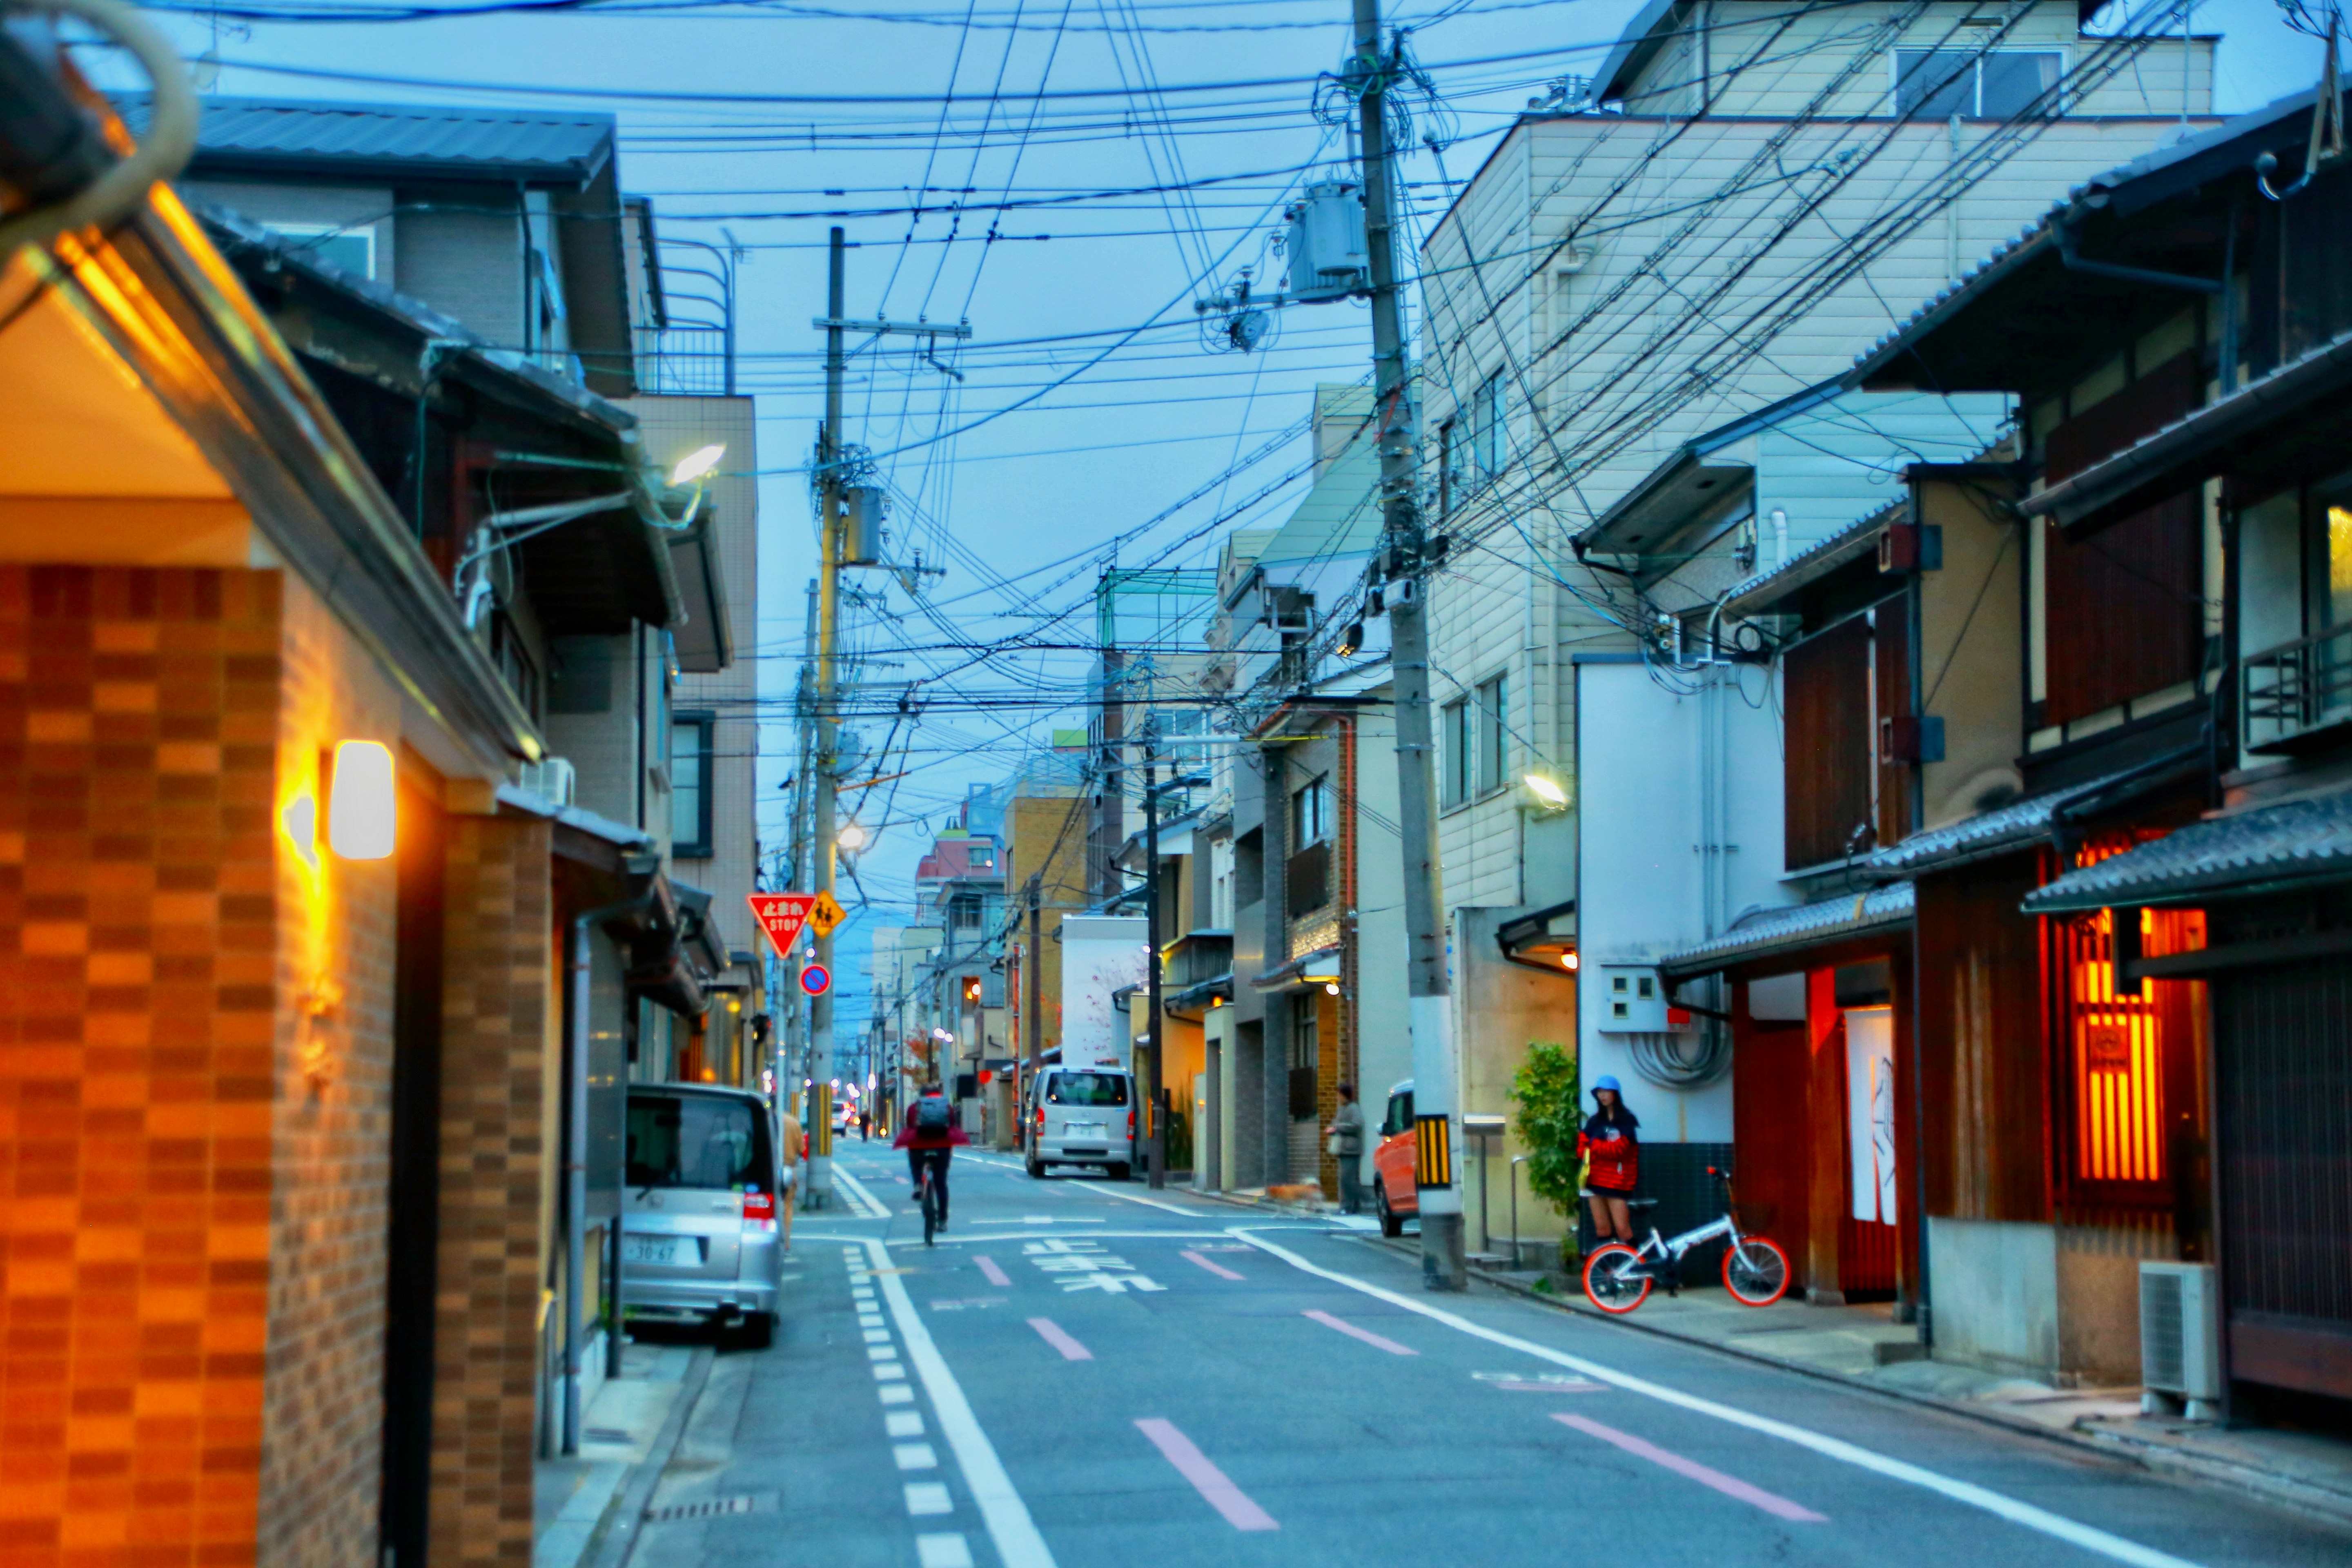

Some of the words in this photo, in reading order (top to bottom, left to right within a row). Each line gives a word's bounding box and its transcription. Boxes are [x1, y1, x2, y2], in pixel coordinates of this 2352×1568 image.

[762, 901, 804, 916] 止まれ
[770, 918, 799, 931] STOP
